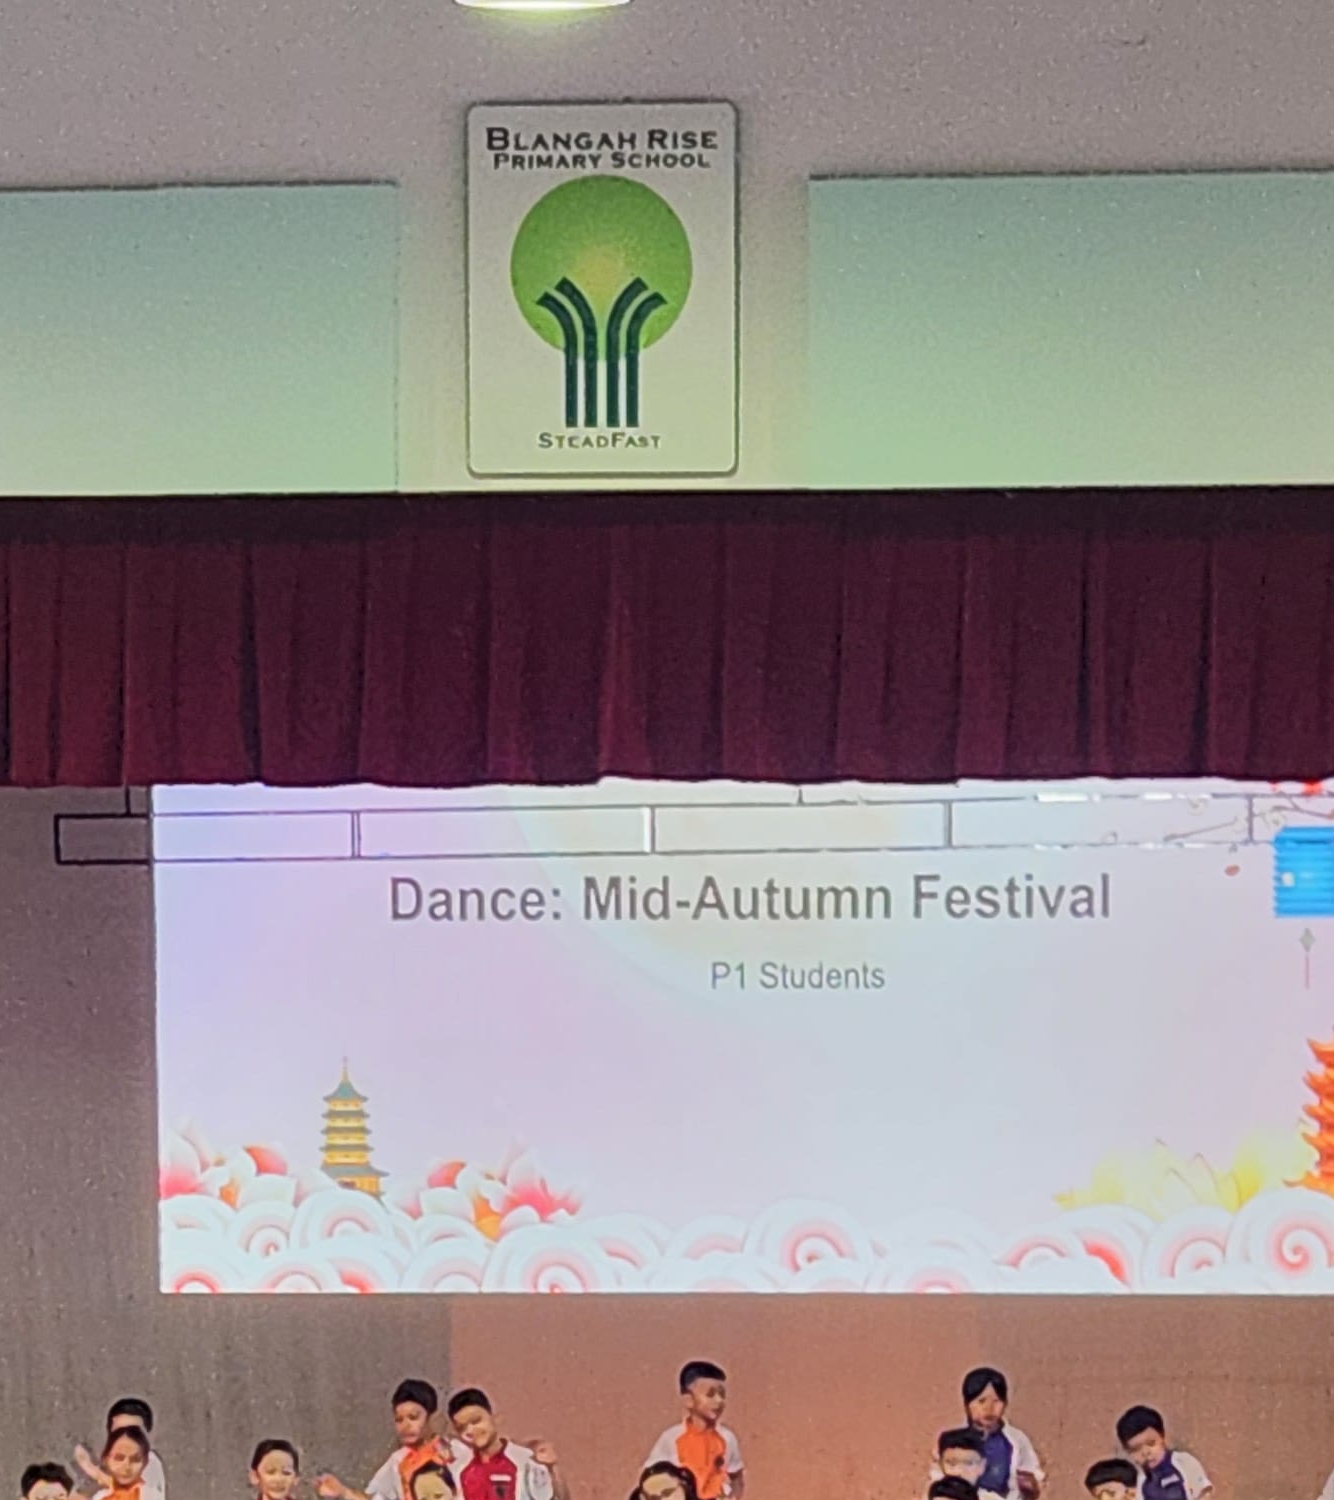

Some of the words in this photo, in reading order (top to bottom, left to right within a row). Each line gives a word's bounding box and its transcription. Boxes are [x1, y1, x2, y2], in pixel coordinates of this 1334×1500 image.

[485, 126, 637, 151] BLANGAH
[647, 129, 719, 150] RISE
[493, 152, 603, 170] PRIMARY
[611, 151, 711, 169] SCHOOL
[390, 876, 562, 922] Dance:
[583, 874, 893, 921] Mid-Autumn
[912, 872, 1112, 920] Festival
[710, 961, 748, 990] P1
[759, 960, 886, 991] Students
